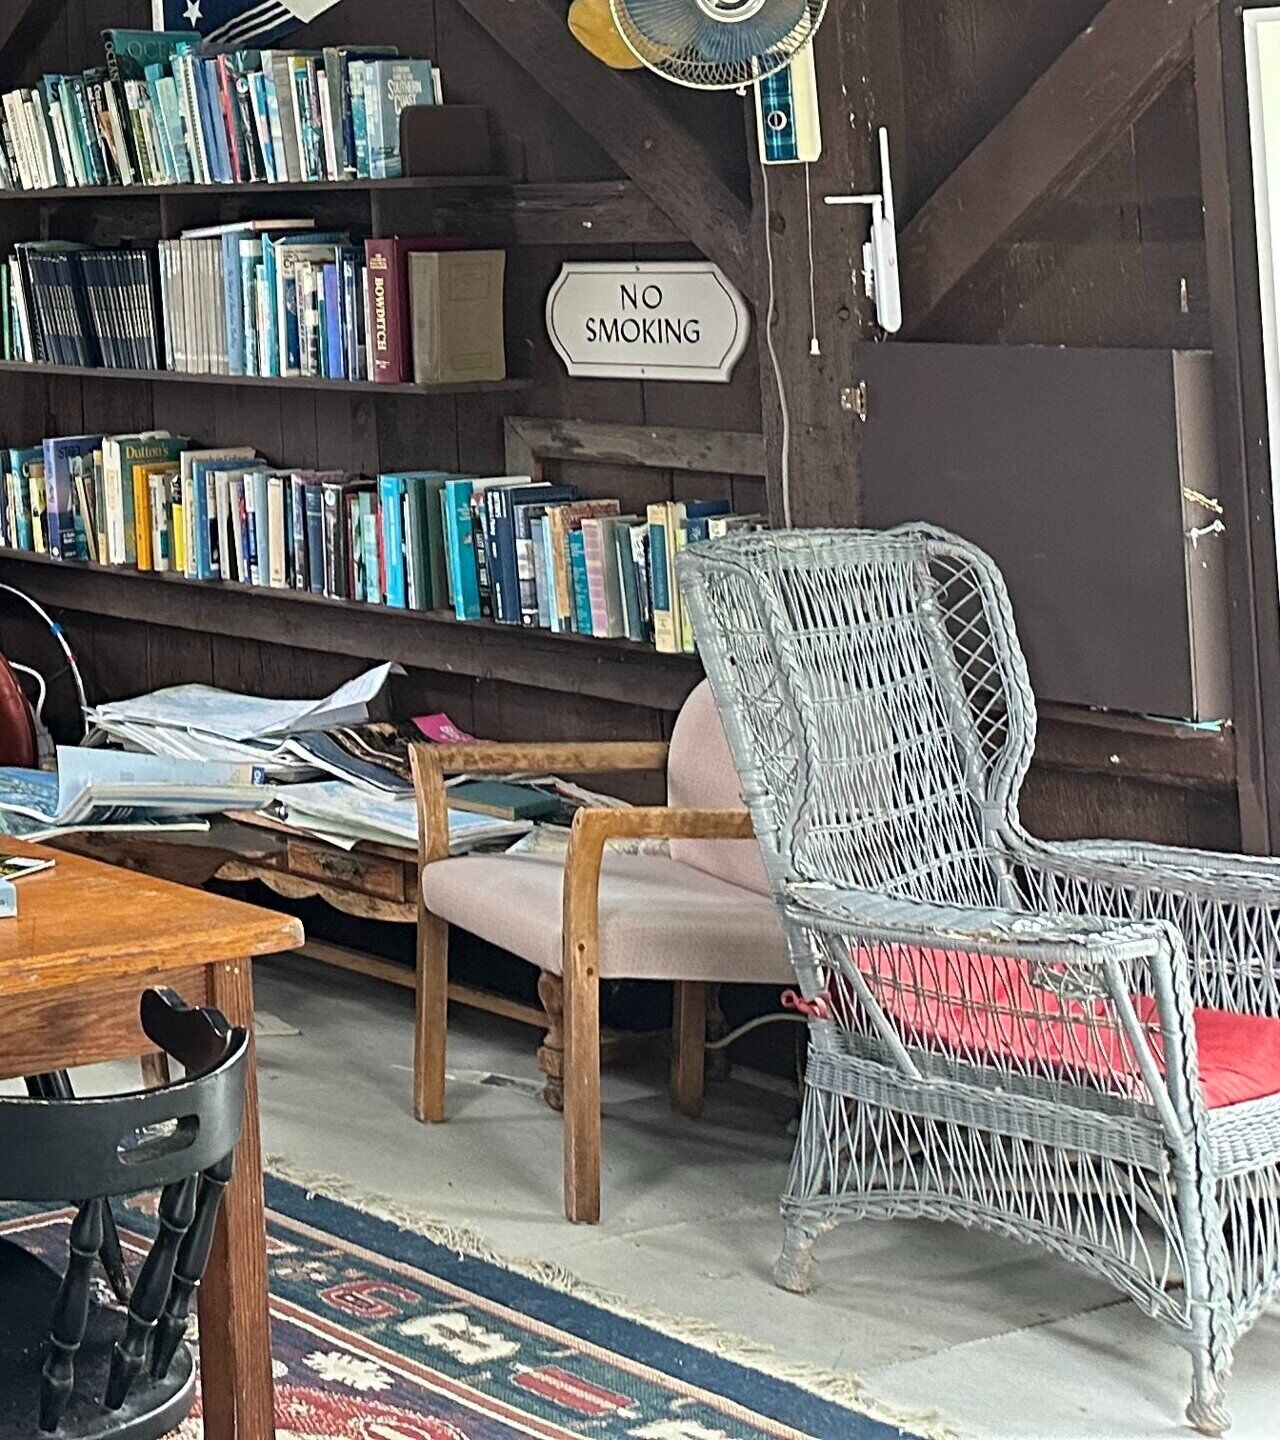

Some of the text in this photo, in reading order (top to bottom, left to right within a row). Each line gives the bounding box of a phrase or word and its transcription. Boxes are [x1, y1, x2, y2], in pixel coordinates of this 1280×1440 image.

[620, 283, 663, 311] NO
[374, 277, 388, 351] BOWDITCH
[586, 317, 700, 344] SMOKING
